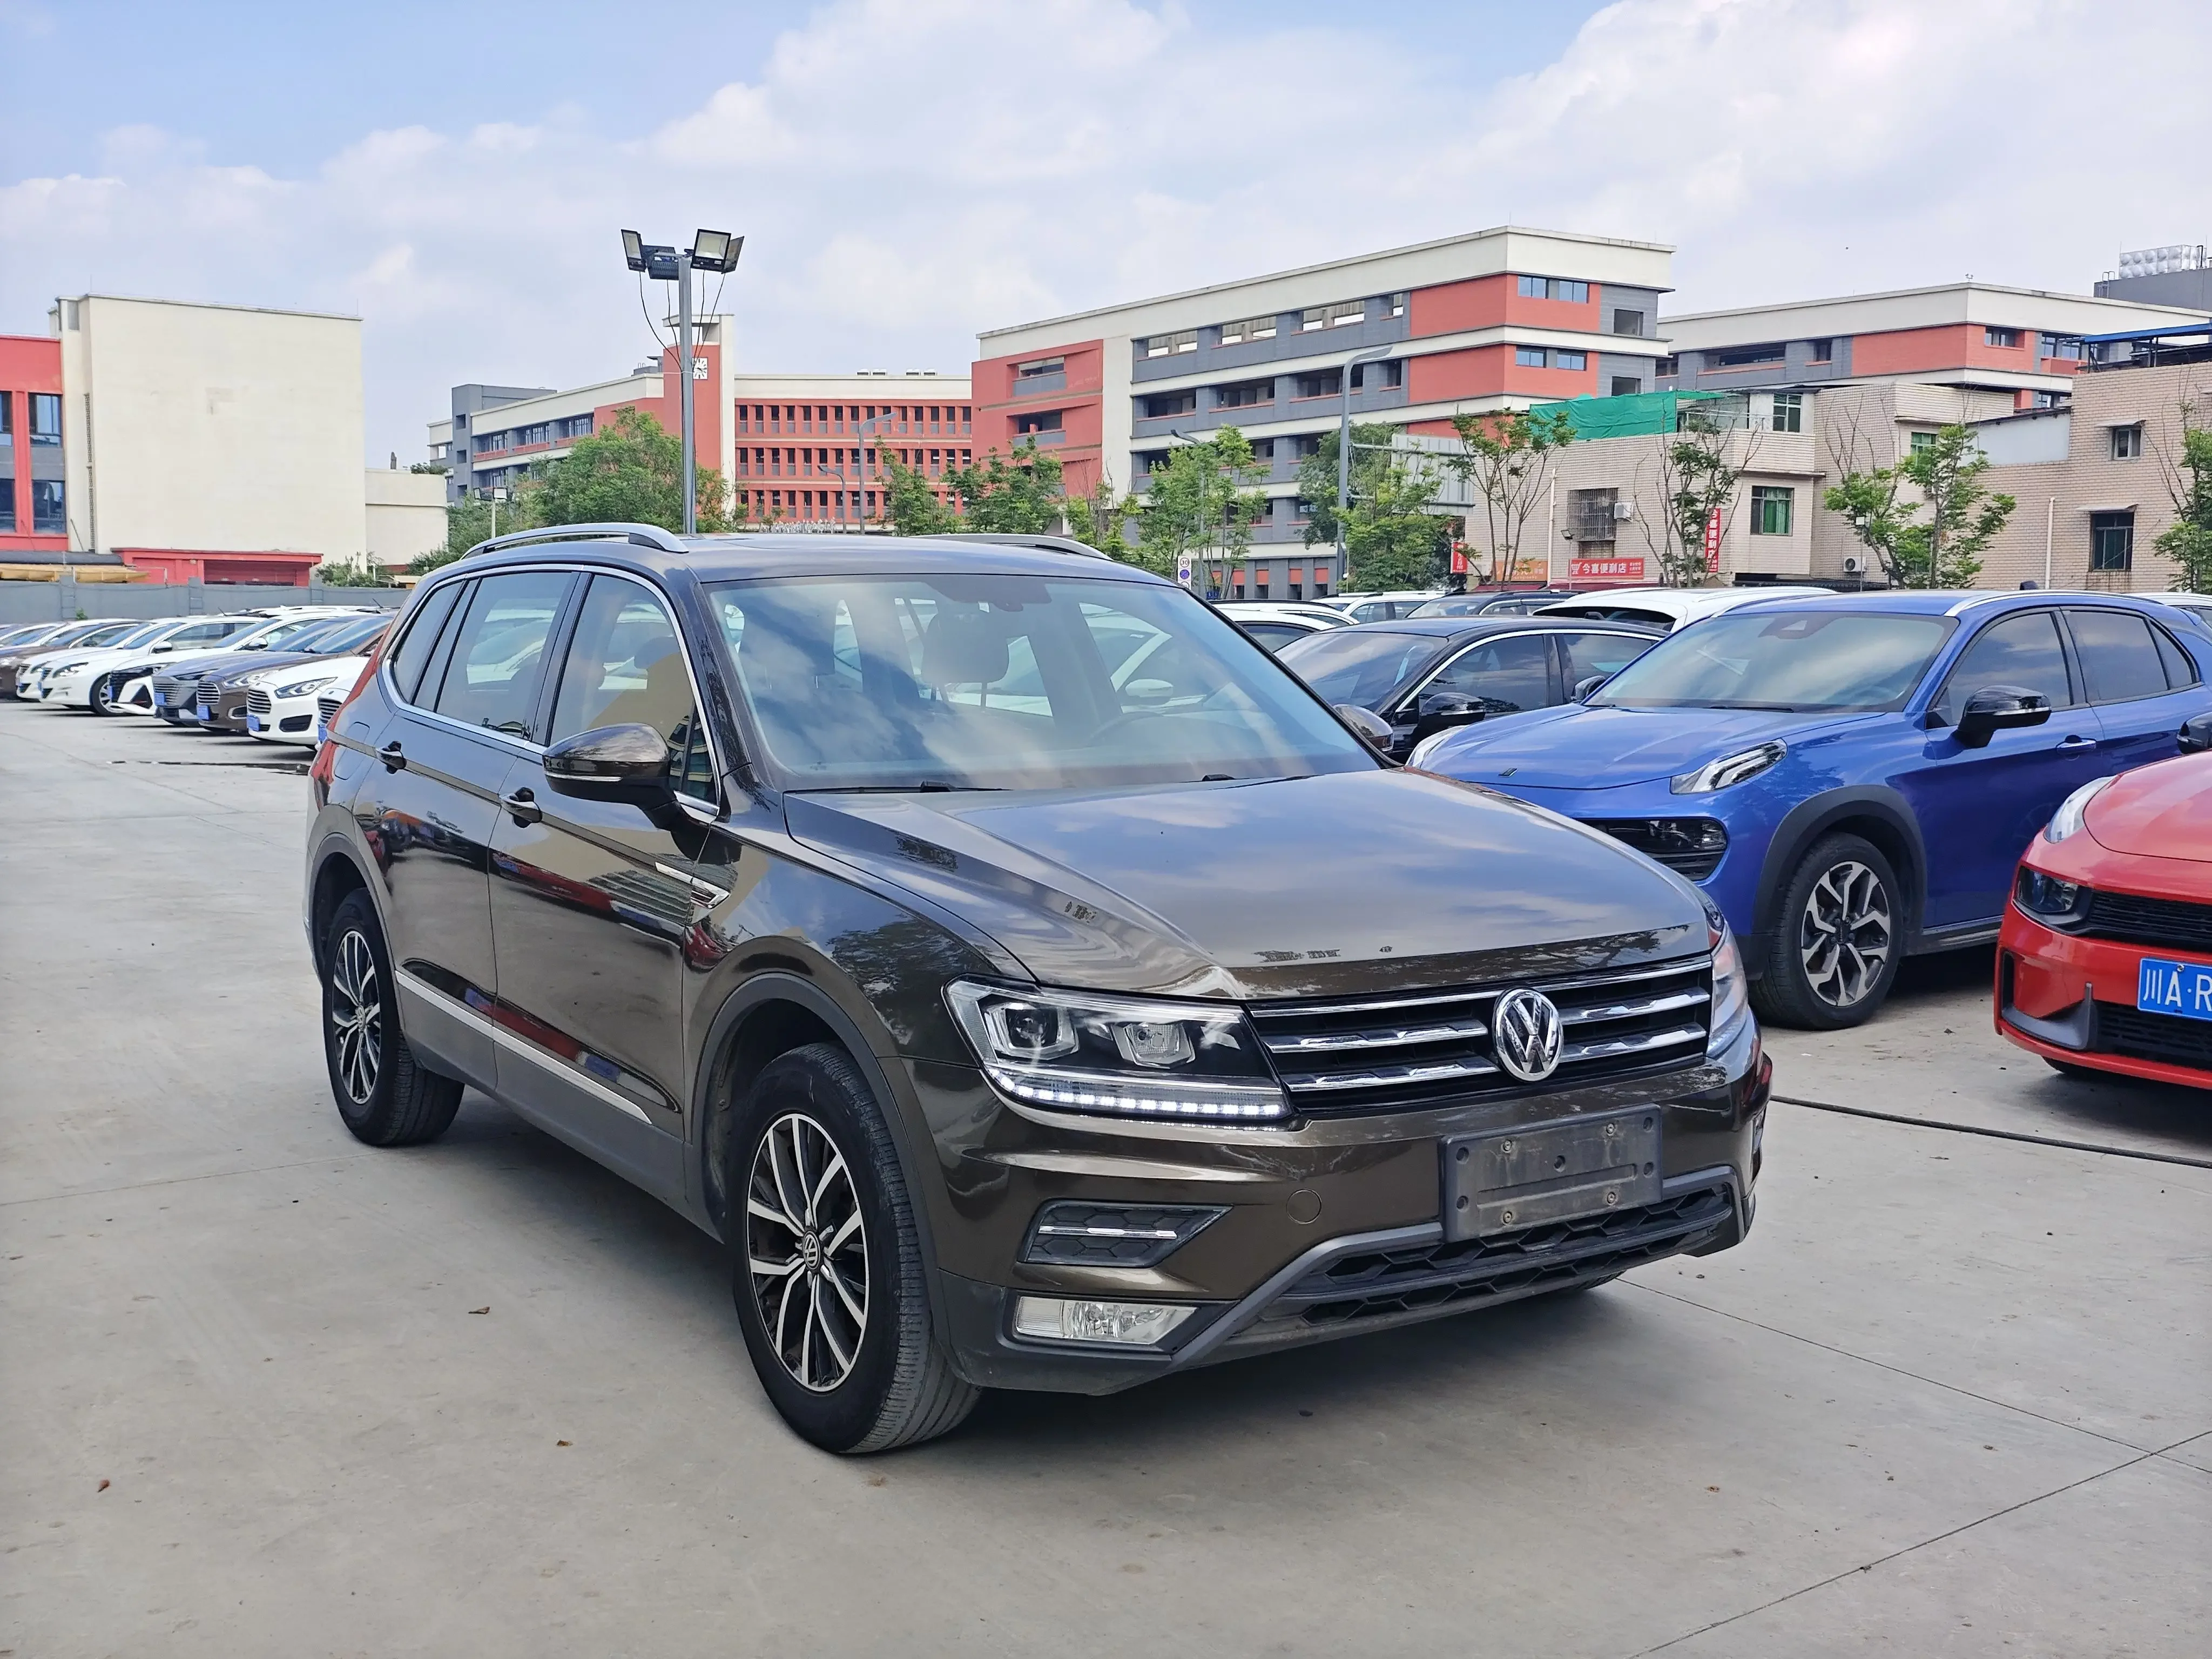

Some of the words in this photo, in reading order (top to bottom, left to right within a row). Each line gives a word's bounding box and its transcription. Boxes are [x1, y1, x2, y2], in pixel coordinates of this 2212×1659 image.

[1582, 562, 1627, 574] 今喜便利店
